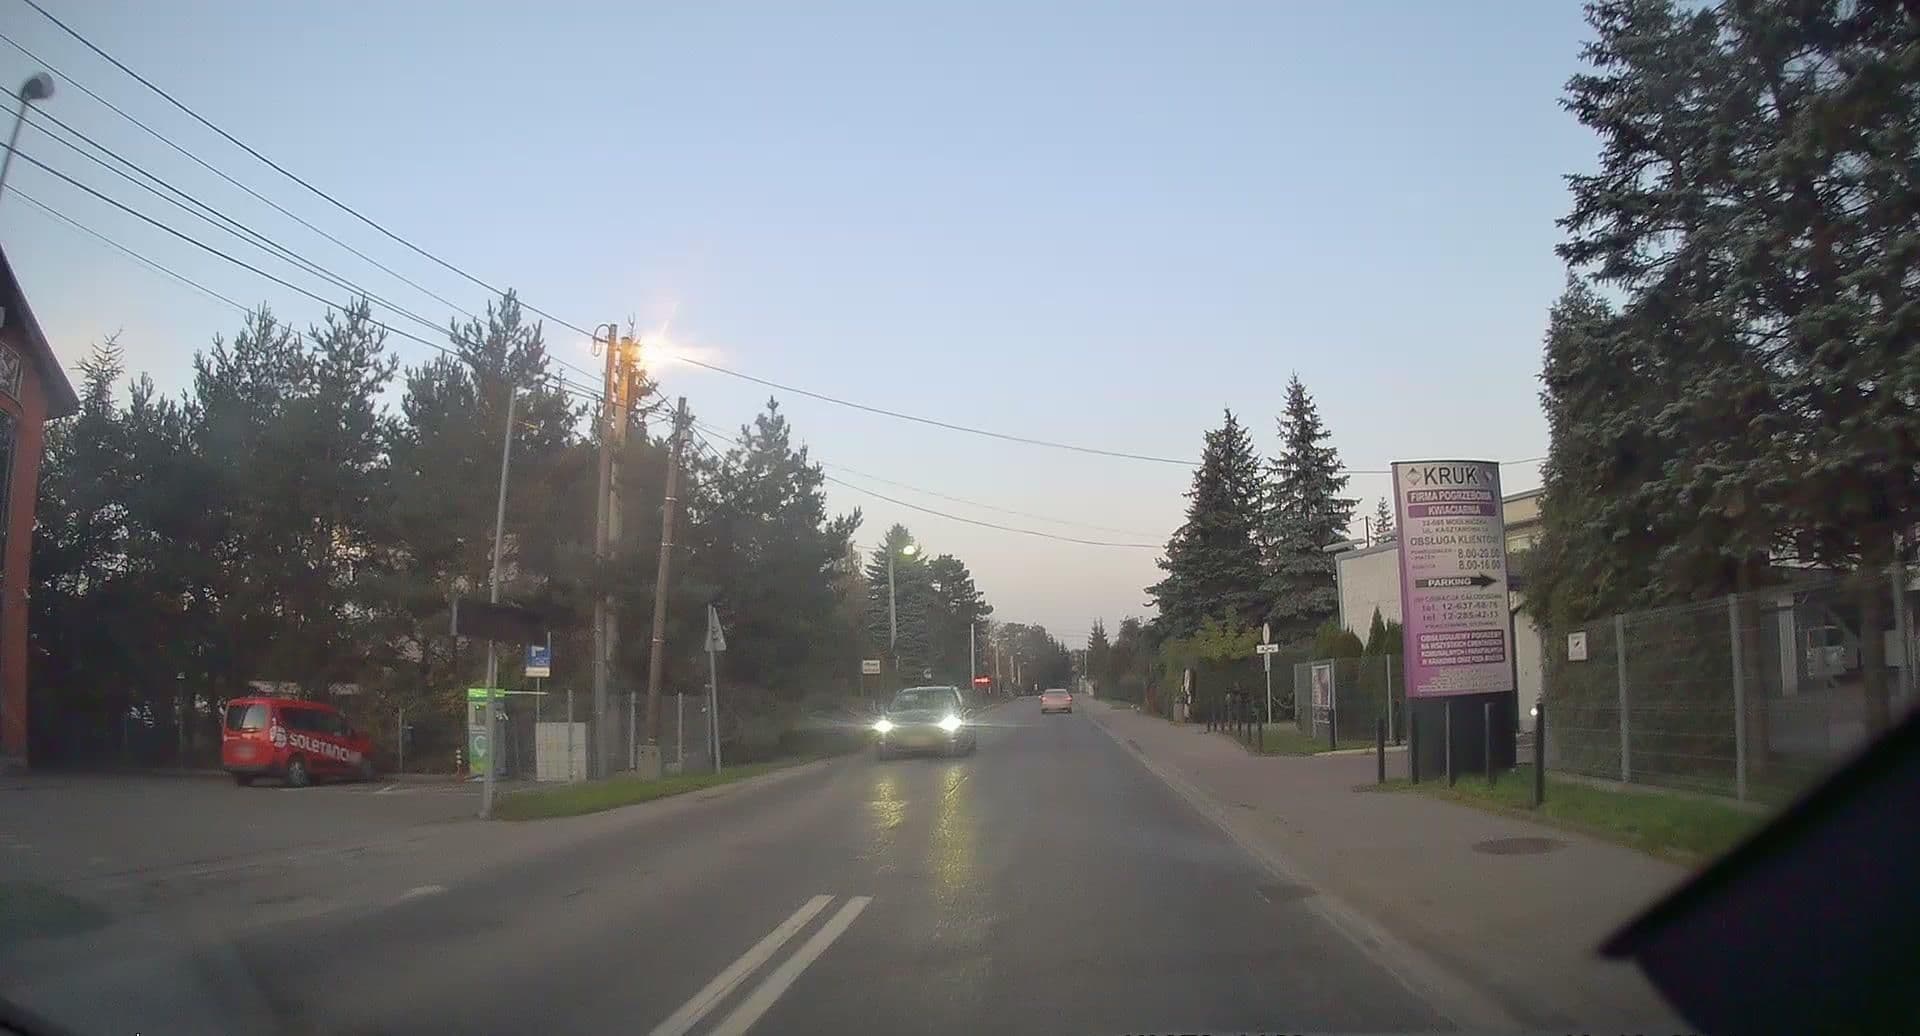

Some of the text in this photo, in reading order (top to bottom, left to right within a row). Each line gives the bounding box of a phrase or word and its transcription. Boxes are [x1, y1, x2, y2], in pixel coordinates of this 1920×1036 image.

[1423, 467, 1479, 485] KRUK
[1410, 491, 1438, 501] FIRMA
[1410, 536, 1456, 546] OBSŁUGA
[1428, 577, 1472, 587] PARKING
[289, 734, 363, 764] SOLETANC
